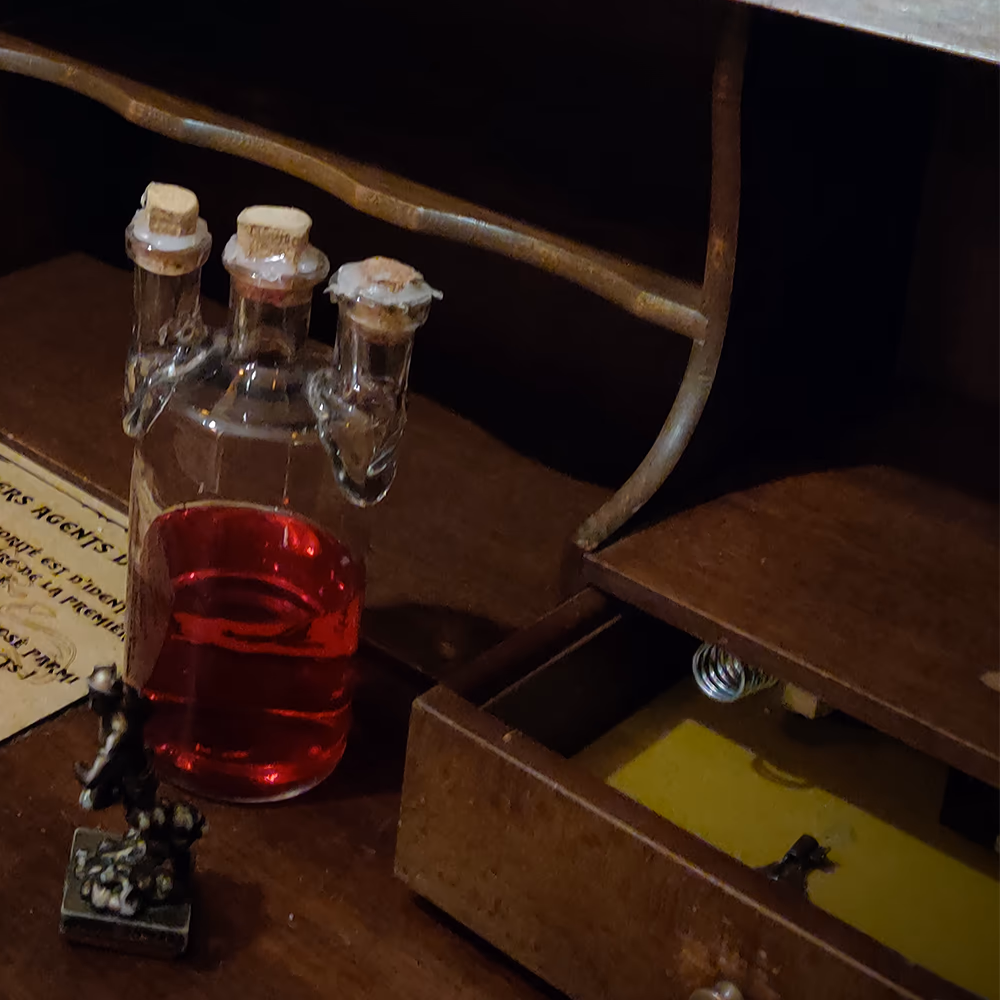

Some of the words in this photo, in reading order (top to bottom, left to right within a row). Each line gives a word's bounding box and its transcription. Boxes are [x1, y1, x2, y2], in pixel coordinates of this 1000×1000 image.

[31, 506, 114, 553] AGENTS
[17, 565, 42, 583] DE
[40, 581, 63, 598] LA
[41, 557, 69, 576] EST
[21, 648, 80, 684] PARMI
